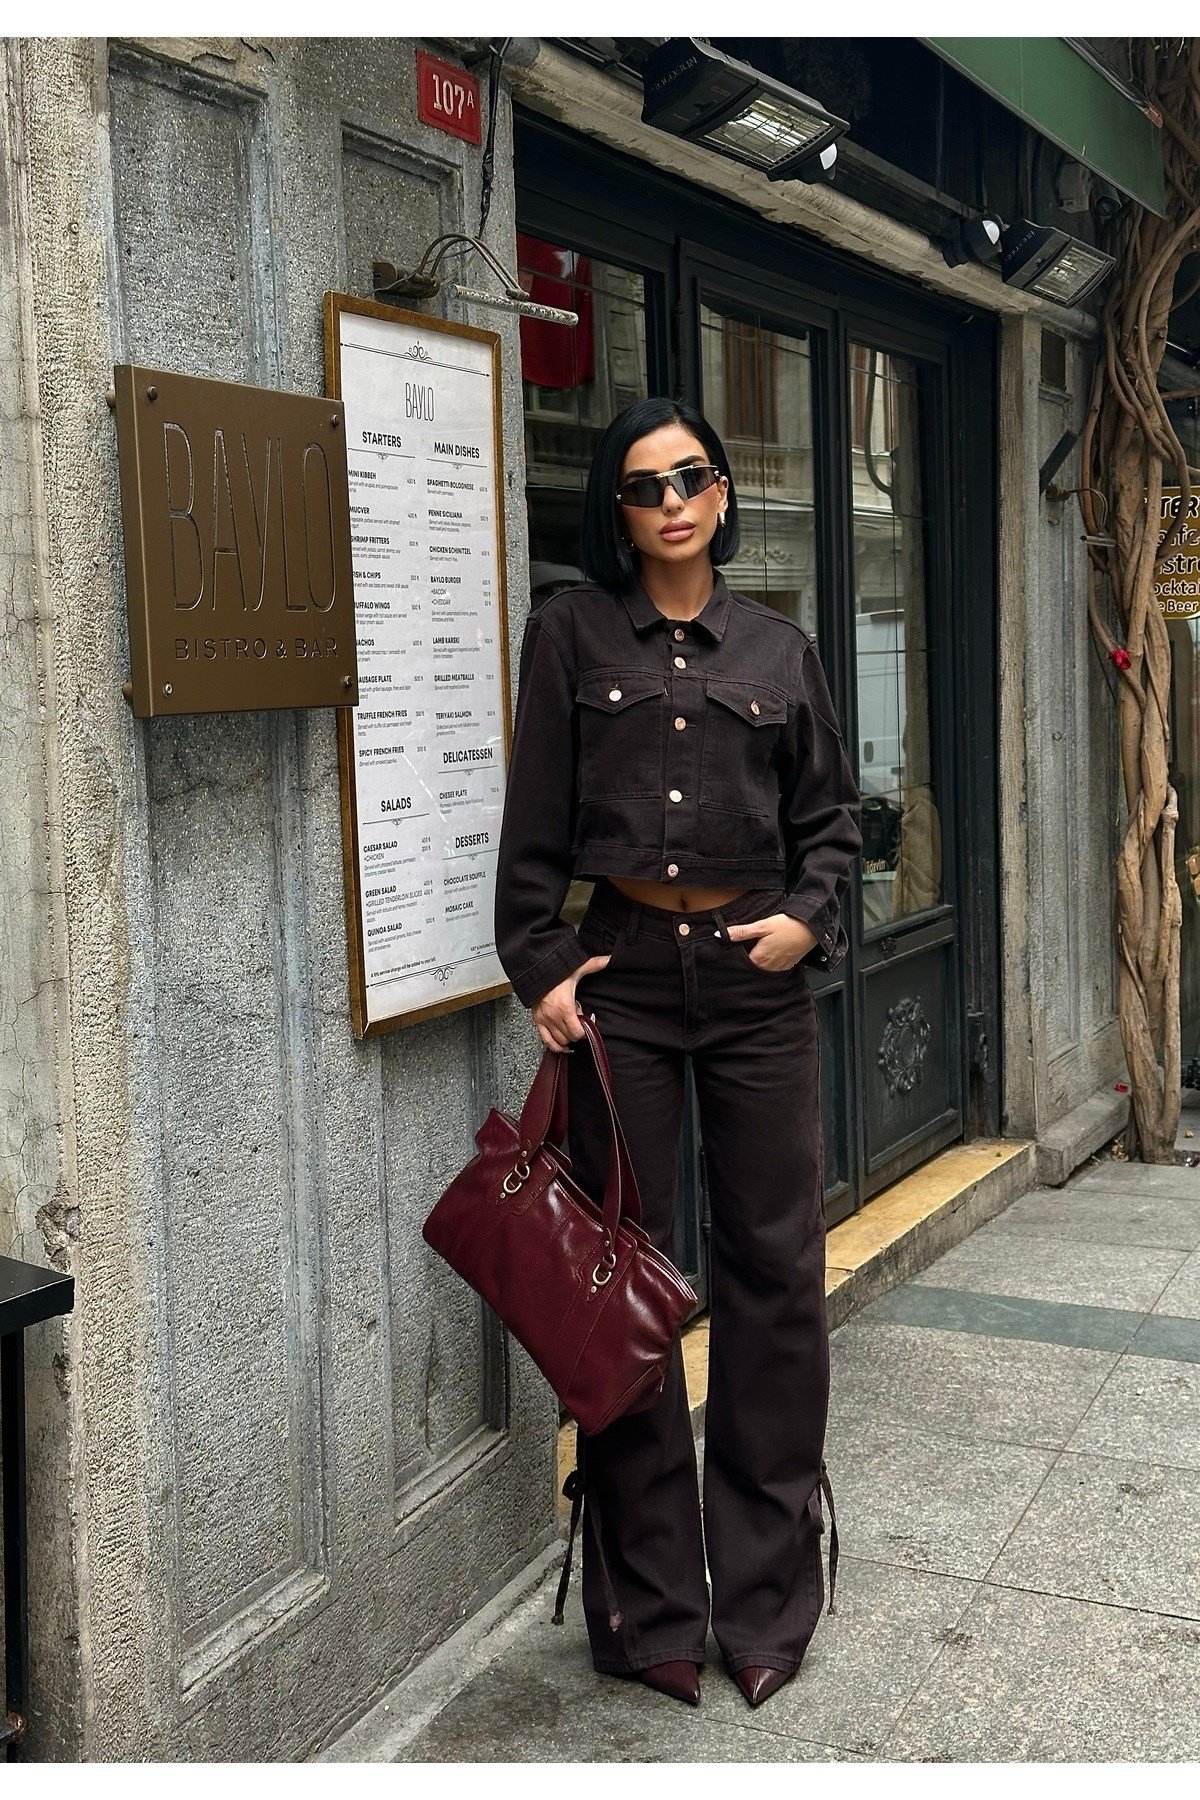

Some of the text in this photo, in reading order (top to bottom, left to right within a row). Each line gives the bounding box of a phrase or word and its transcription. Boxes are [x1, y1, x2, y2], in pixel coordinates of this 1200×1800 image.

[432, 74, 475, 119] 107A
[406, 382, 434, 422] BAYLO
[362, 431, 402, 448] STARTERS
[434, 442, 480, 458] MAIN DISHES
[360, 471, 376, 479] KIBBEH
[427, 479, 449, 488] SPAGHETTI
[450, 482, 474, 490] BOLOGNESE
[163, 421, 337, 613] BAYLO
[350, 506, 370, 514] MUCVER
[1167, 600, 1198, 612] Beer
[174, 638, 268, 660] BISTRO
[276, 639, 288, 660] &
[295, 638, 338, 658] BAR
[374, 747, 391, 756] FRENCH
[443, 748, 492, 764] DELICATESSEN
[381, 797, 411, 812] SALADS
[363, 843, 382, 853] CAESAR
[383, 841, 398, 850] SALAD
[456, 832, 489, 848] DESSERTS
[444, 871, 486, 886] CHOCOLATE SOUFFLE
[365, 888, 381, 898] GREEN
[382, 885, 396, 894] SALAD
[385, 894, 409, 903] TENDERLOIN
[410, 890, 422, 899] SLICES
[445, 901, 474, 913] MOSAIC CAKE
[368, 926, 386, 936] QUINOA
[387, 923, 402, 932] SALAD
